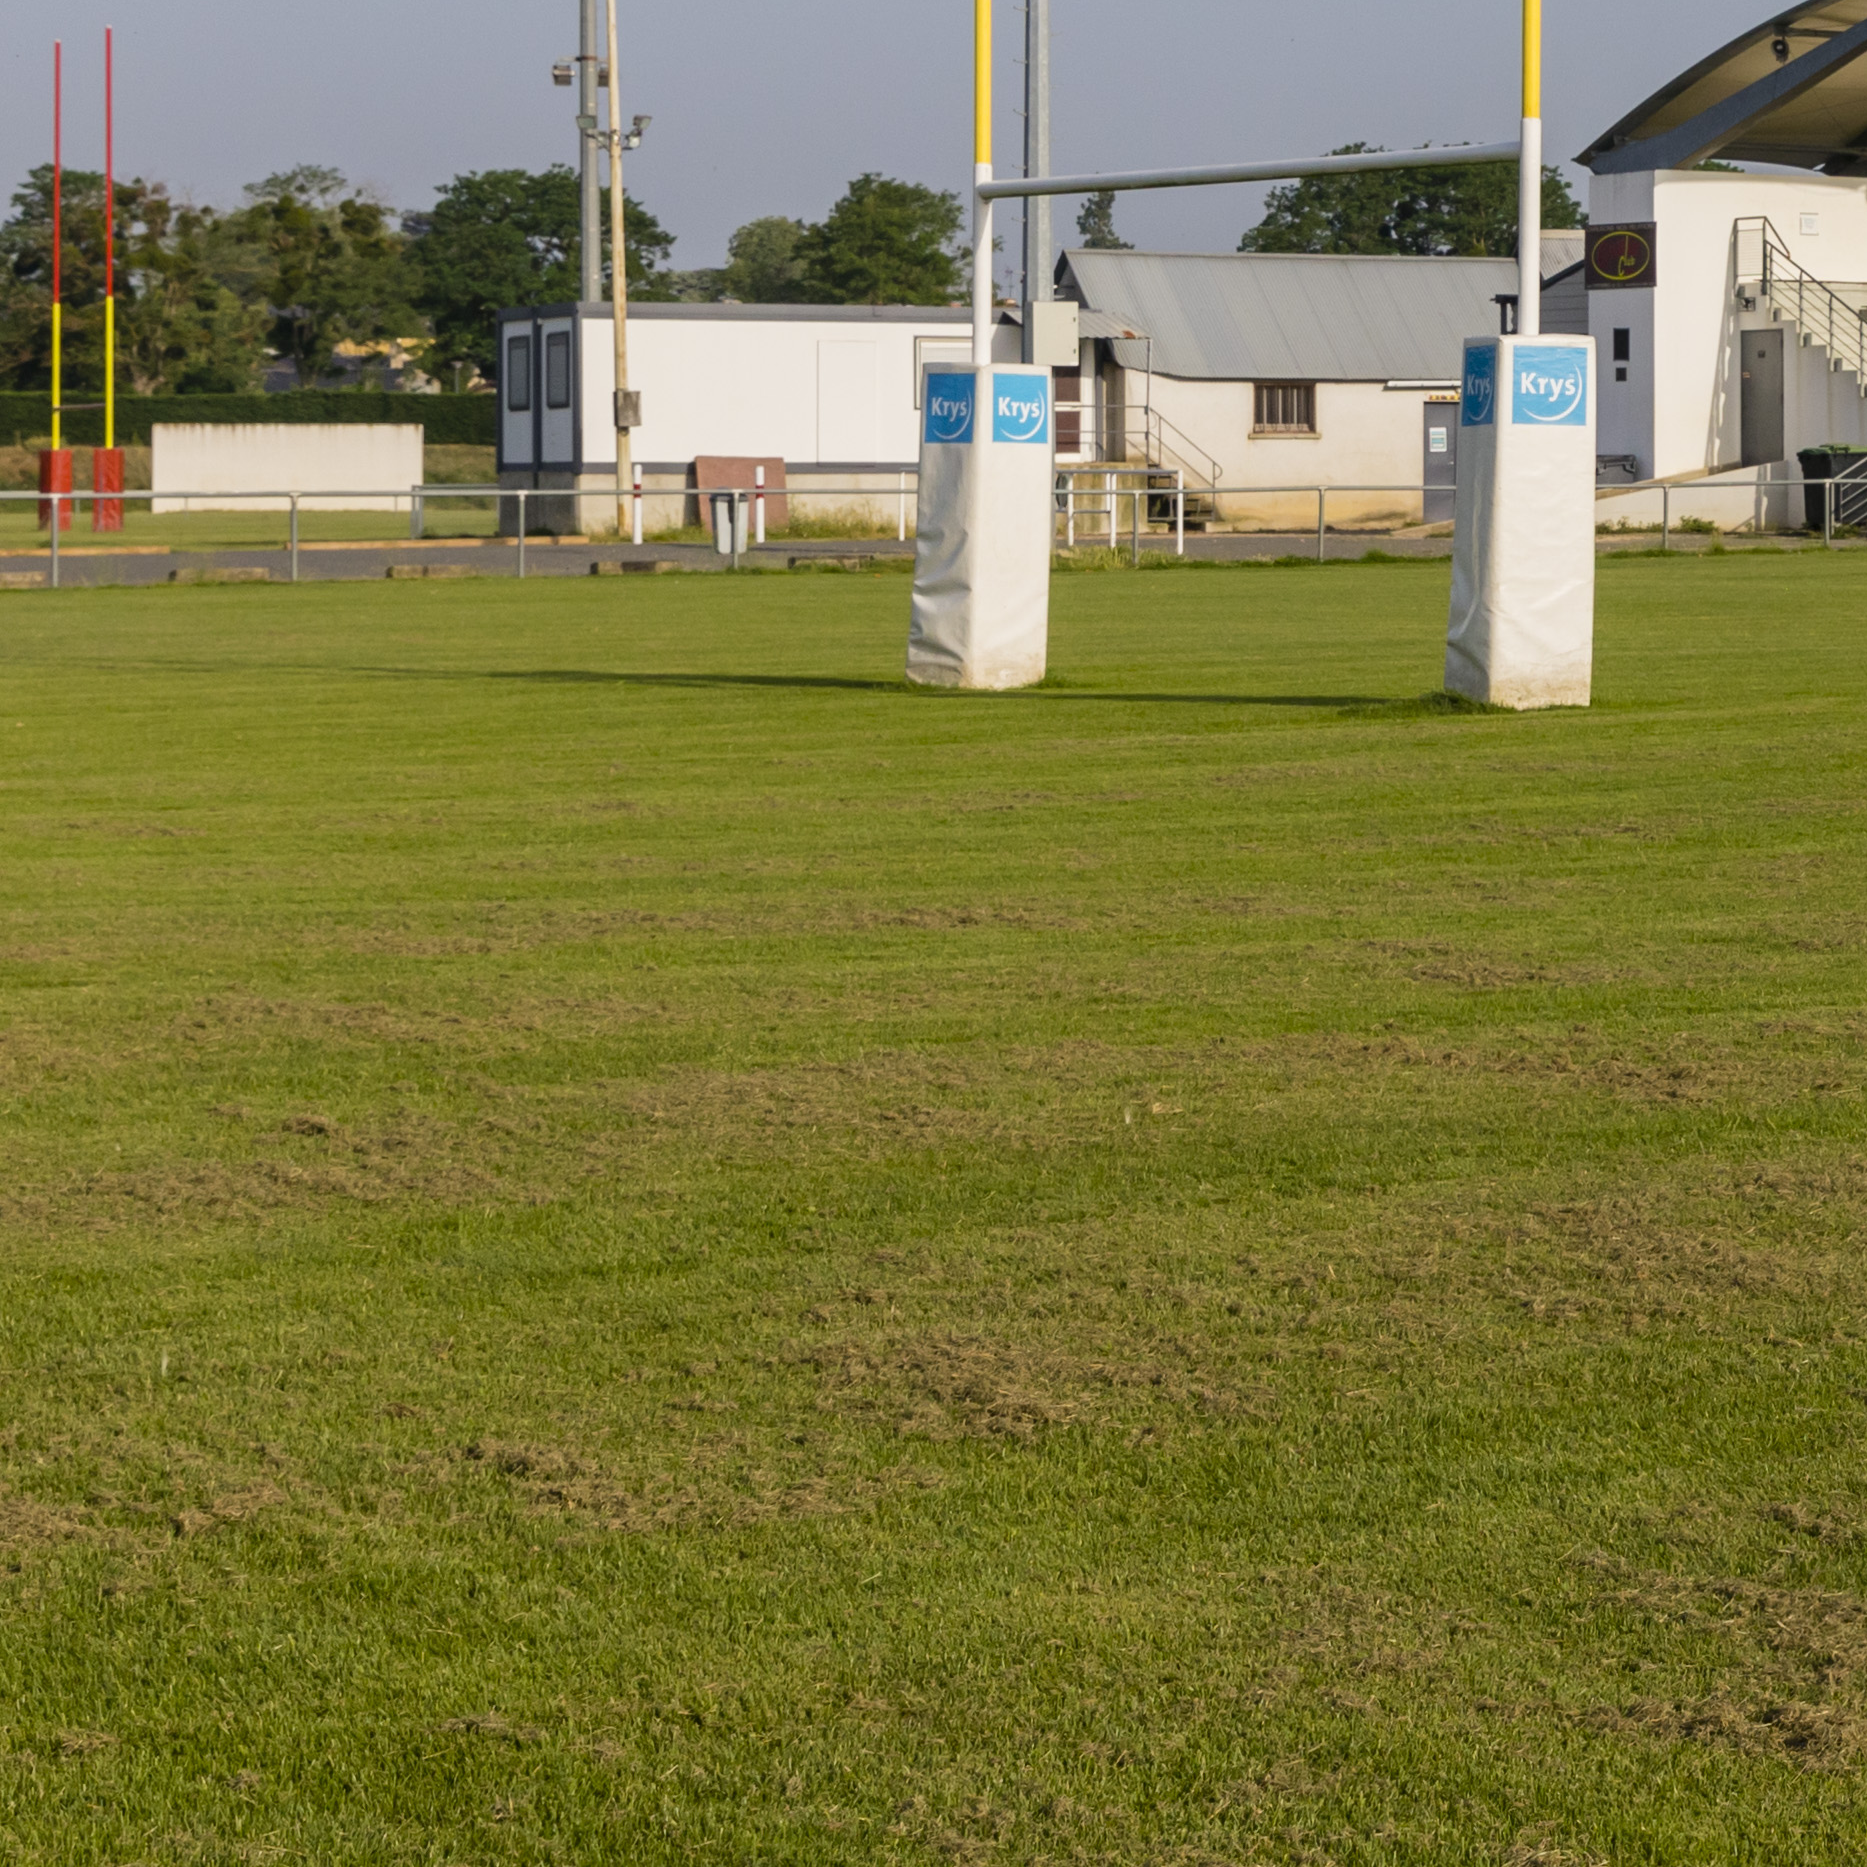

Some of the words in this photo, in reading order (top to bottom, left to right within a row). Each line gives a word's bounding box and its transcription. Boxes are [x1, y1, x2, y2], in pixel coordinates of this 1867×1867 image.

[1467, 375, 1491, 403] Krys
[1521, 372, 1576, 402] Krys
[931, 397, 967, 422] Krys
[998, 397, 1041, 423] Krys
